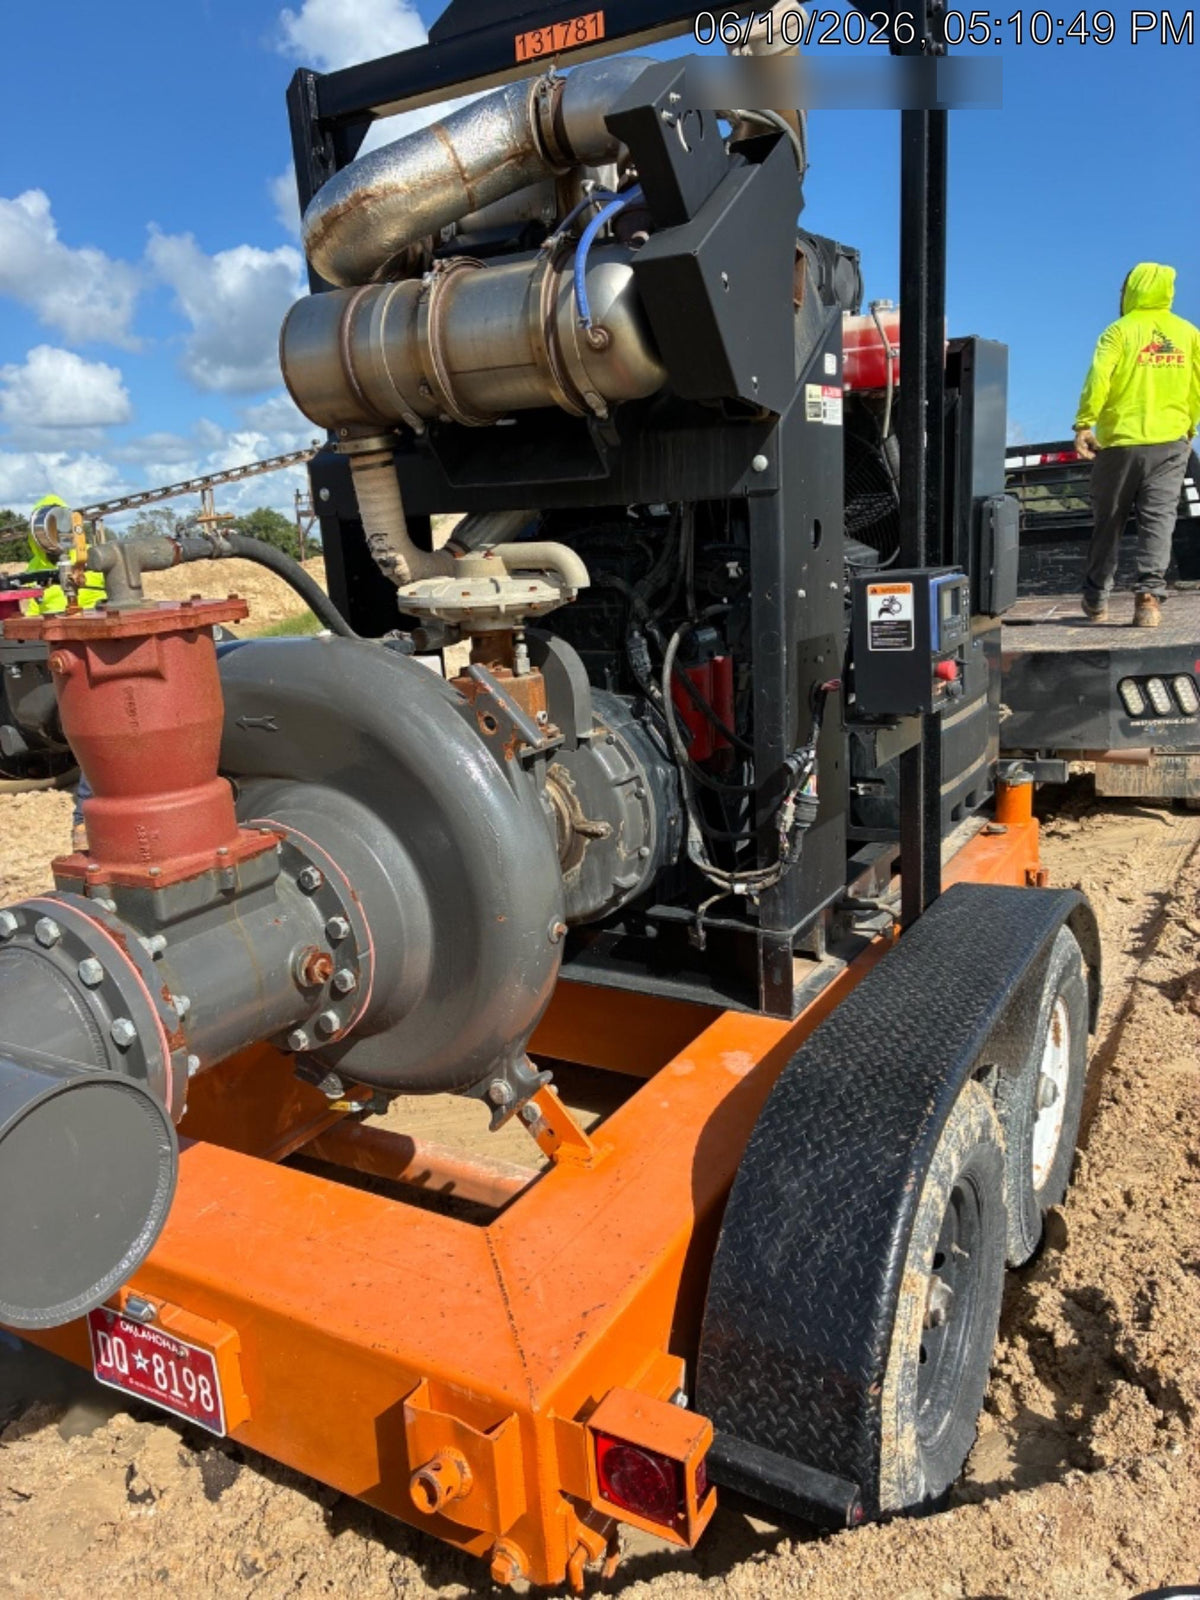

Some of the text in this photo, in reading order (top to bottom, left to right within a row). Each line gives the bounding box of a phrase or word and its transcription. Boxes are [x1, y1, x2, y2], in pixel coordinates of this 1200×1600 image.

[518, 13, 600, 58] 131781
[120, 1320, 180, 1354] OKLAHOMA
[97, 1330, 129, 1375] DQ
[152, 1353, 214, 1412] 8198
